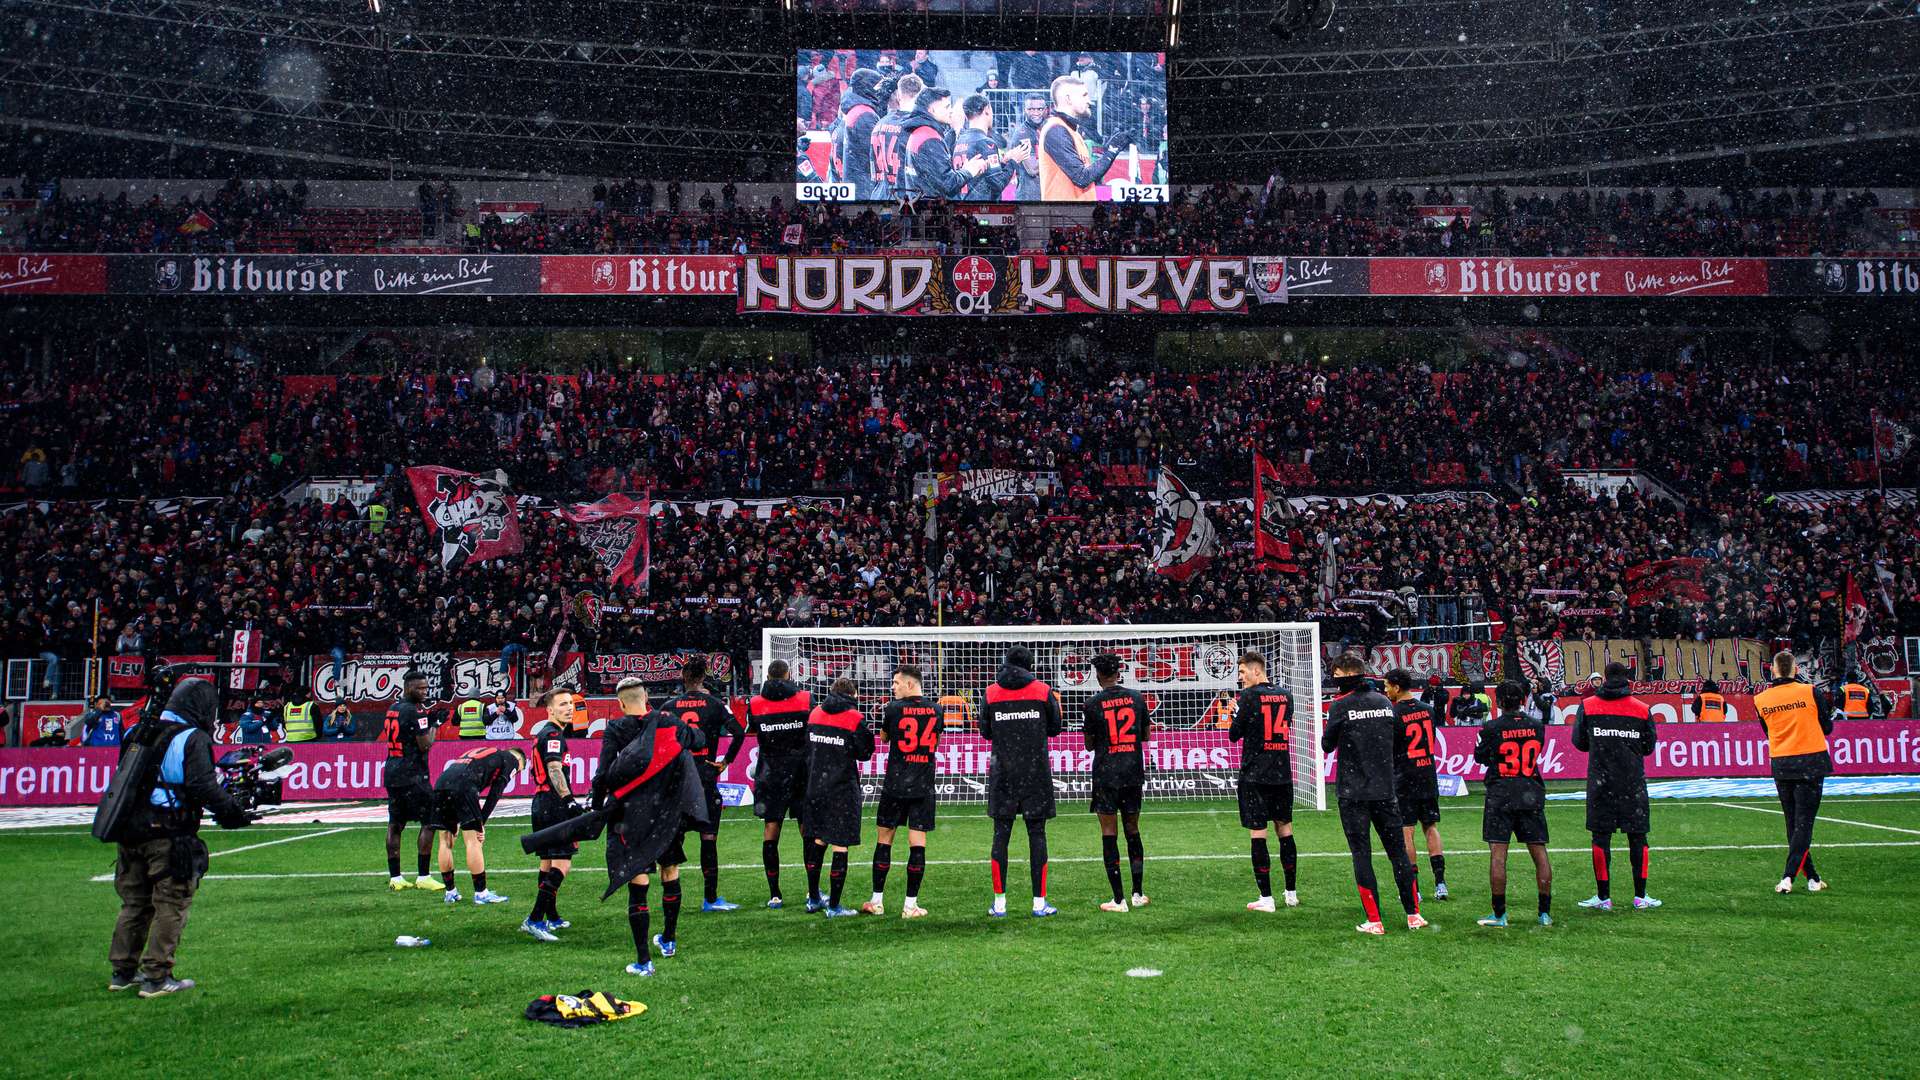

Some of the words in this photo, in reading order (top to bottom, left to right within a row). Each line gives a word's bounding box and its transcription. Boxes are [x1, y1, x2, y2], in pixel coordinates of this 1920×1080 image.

[803, 186, 849, 199] 90:00
[1119, 186, 1162, 200] 19:27
[190, 257, 349, 292] Bitburger
[374, 268, 417, 292] Bitte
[421, 269, 455, 283] ein
[458, 258, 494, 278] Bit
[627, 258, 738, 293] Bitbur
[745, 257, 933, 312] NORD
[955, 273, 994, 281] BAYER
[1019, 257, 1245, 311] KURVE
[1299, 259, 1333, 281] Bit
[1458, 260, 1600, 293] Bitburger
[1624, 270, 1665, 292] Bitte
[1668, 272, 1700, 285] ein
[1702, 261, 1734, 280] Bit
[1857, 261, 1920, 293] Bitb
[956, 291, 992, 315] 04
[453, 661, 513, 698] 513
[588, 653, 690, 674] JUGEN
[995, 709, 1040, 722] Barmenia
[1262, 704, 1290, 741] 14
[1348, 707, 1393, 721] Barmenia
[1762, 699, 1807, 716] Barmenia
[104, 733, 116, 741] TV
[760, 718, 804, 733] Barmenia
[898, 717, 938, 753] 34
[1104, 707, 1137, 745] 12
[1405, 720, 1434, 759] 21
[1593, 726, 1641, 741] Barmenia
[1047, 741, 1230, 774] maines
[1498, 739, 1542, 778] 30
[0, 757, 111, 794] remiu
